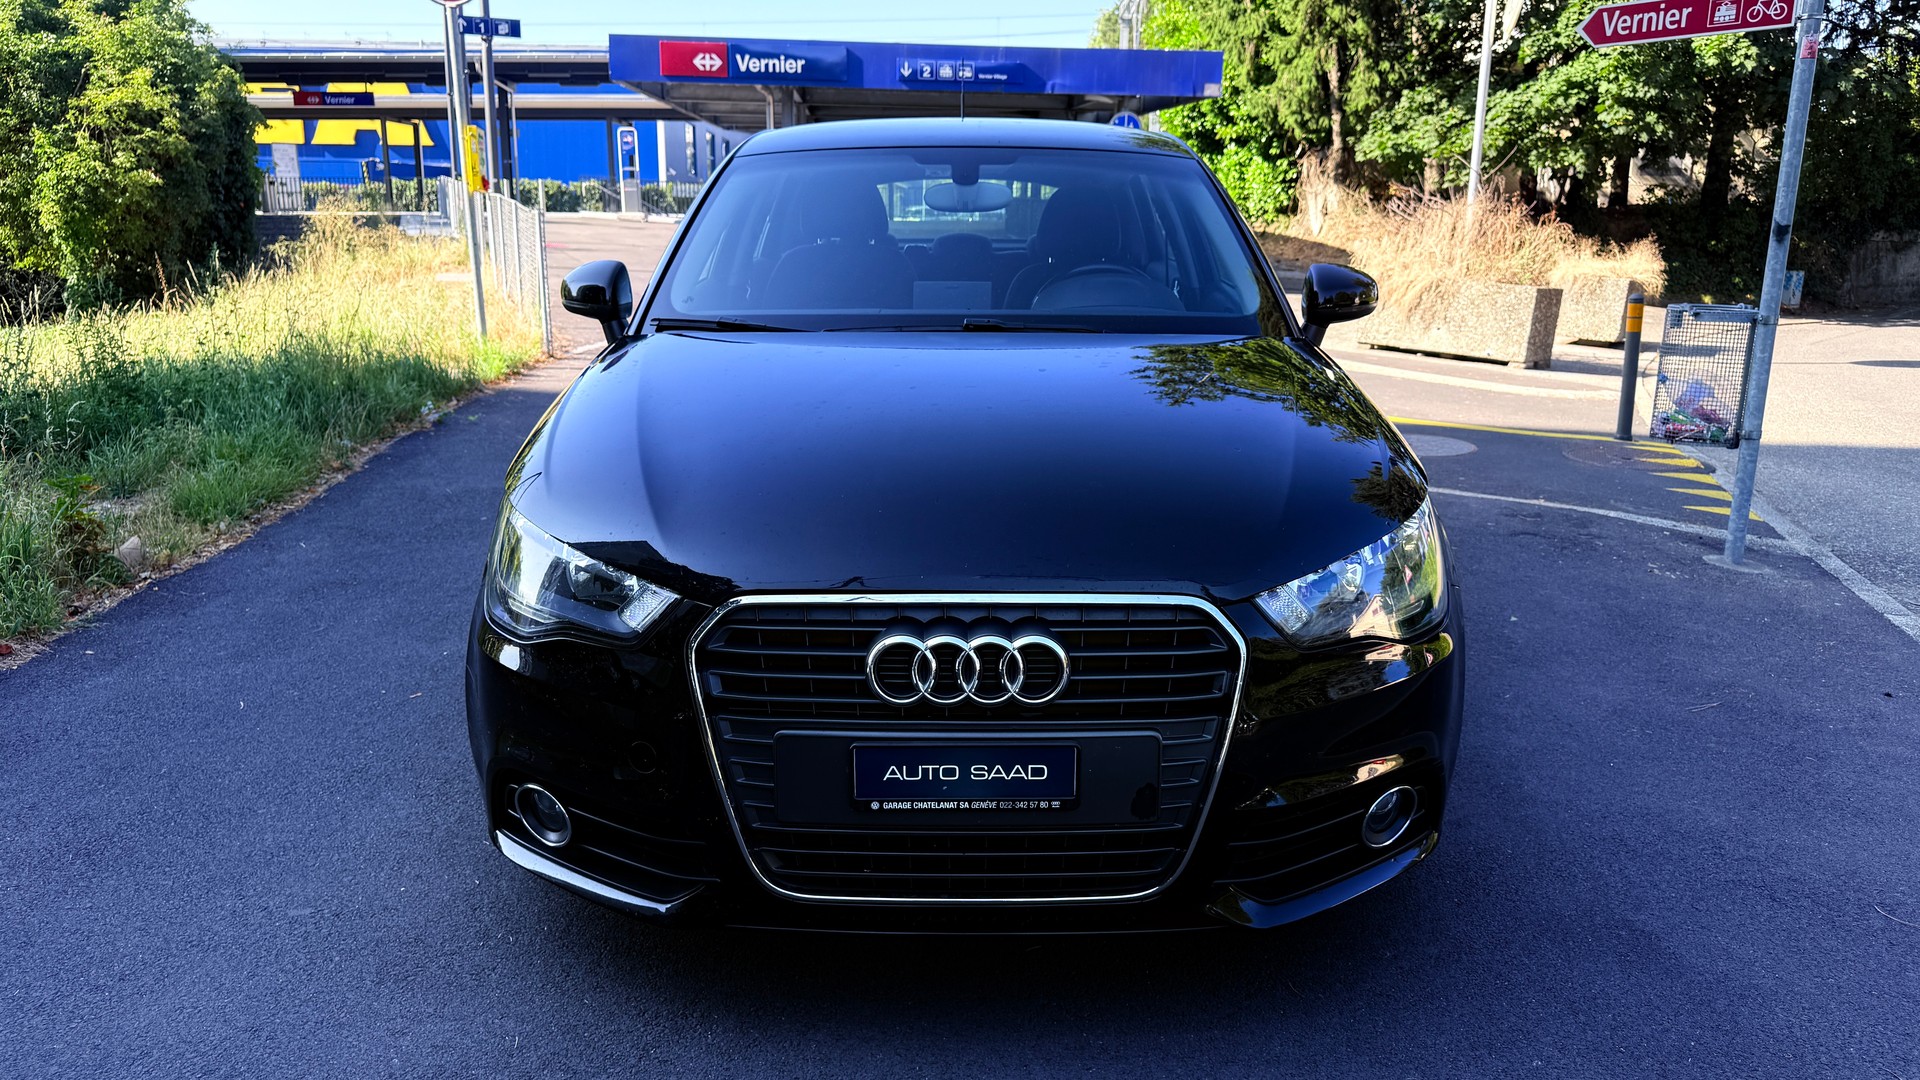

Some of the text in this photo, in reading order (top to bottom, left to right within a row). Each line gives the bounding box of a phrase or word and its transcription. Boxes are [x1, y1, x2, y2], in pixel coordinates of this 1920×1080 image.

[1602, 4, 1692, 37] Vernier
[479, 22, 485, 34] 1
[736, 53, 805, 74] Vernier
[922, 65, 931, 78] 2
[324, 95, 355, 105] Vernier
[883, 765, 1048, 781] AUTO SAAD
[883, 801, 912, 809] GARAGE
[913, 801, 958, 809] CHATELANAT
[959, 801, 970, 809] SA
[999, 801, 1028, 809] 022-342
[1029, 801, 1039, 809] 57
[1039, 801, 1049, 809] 80
